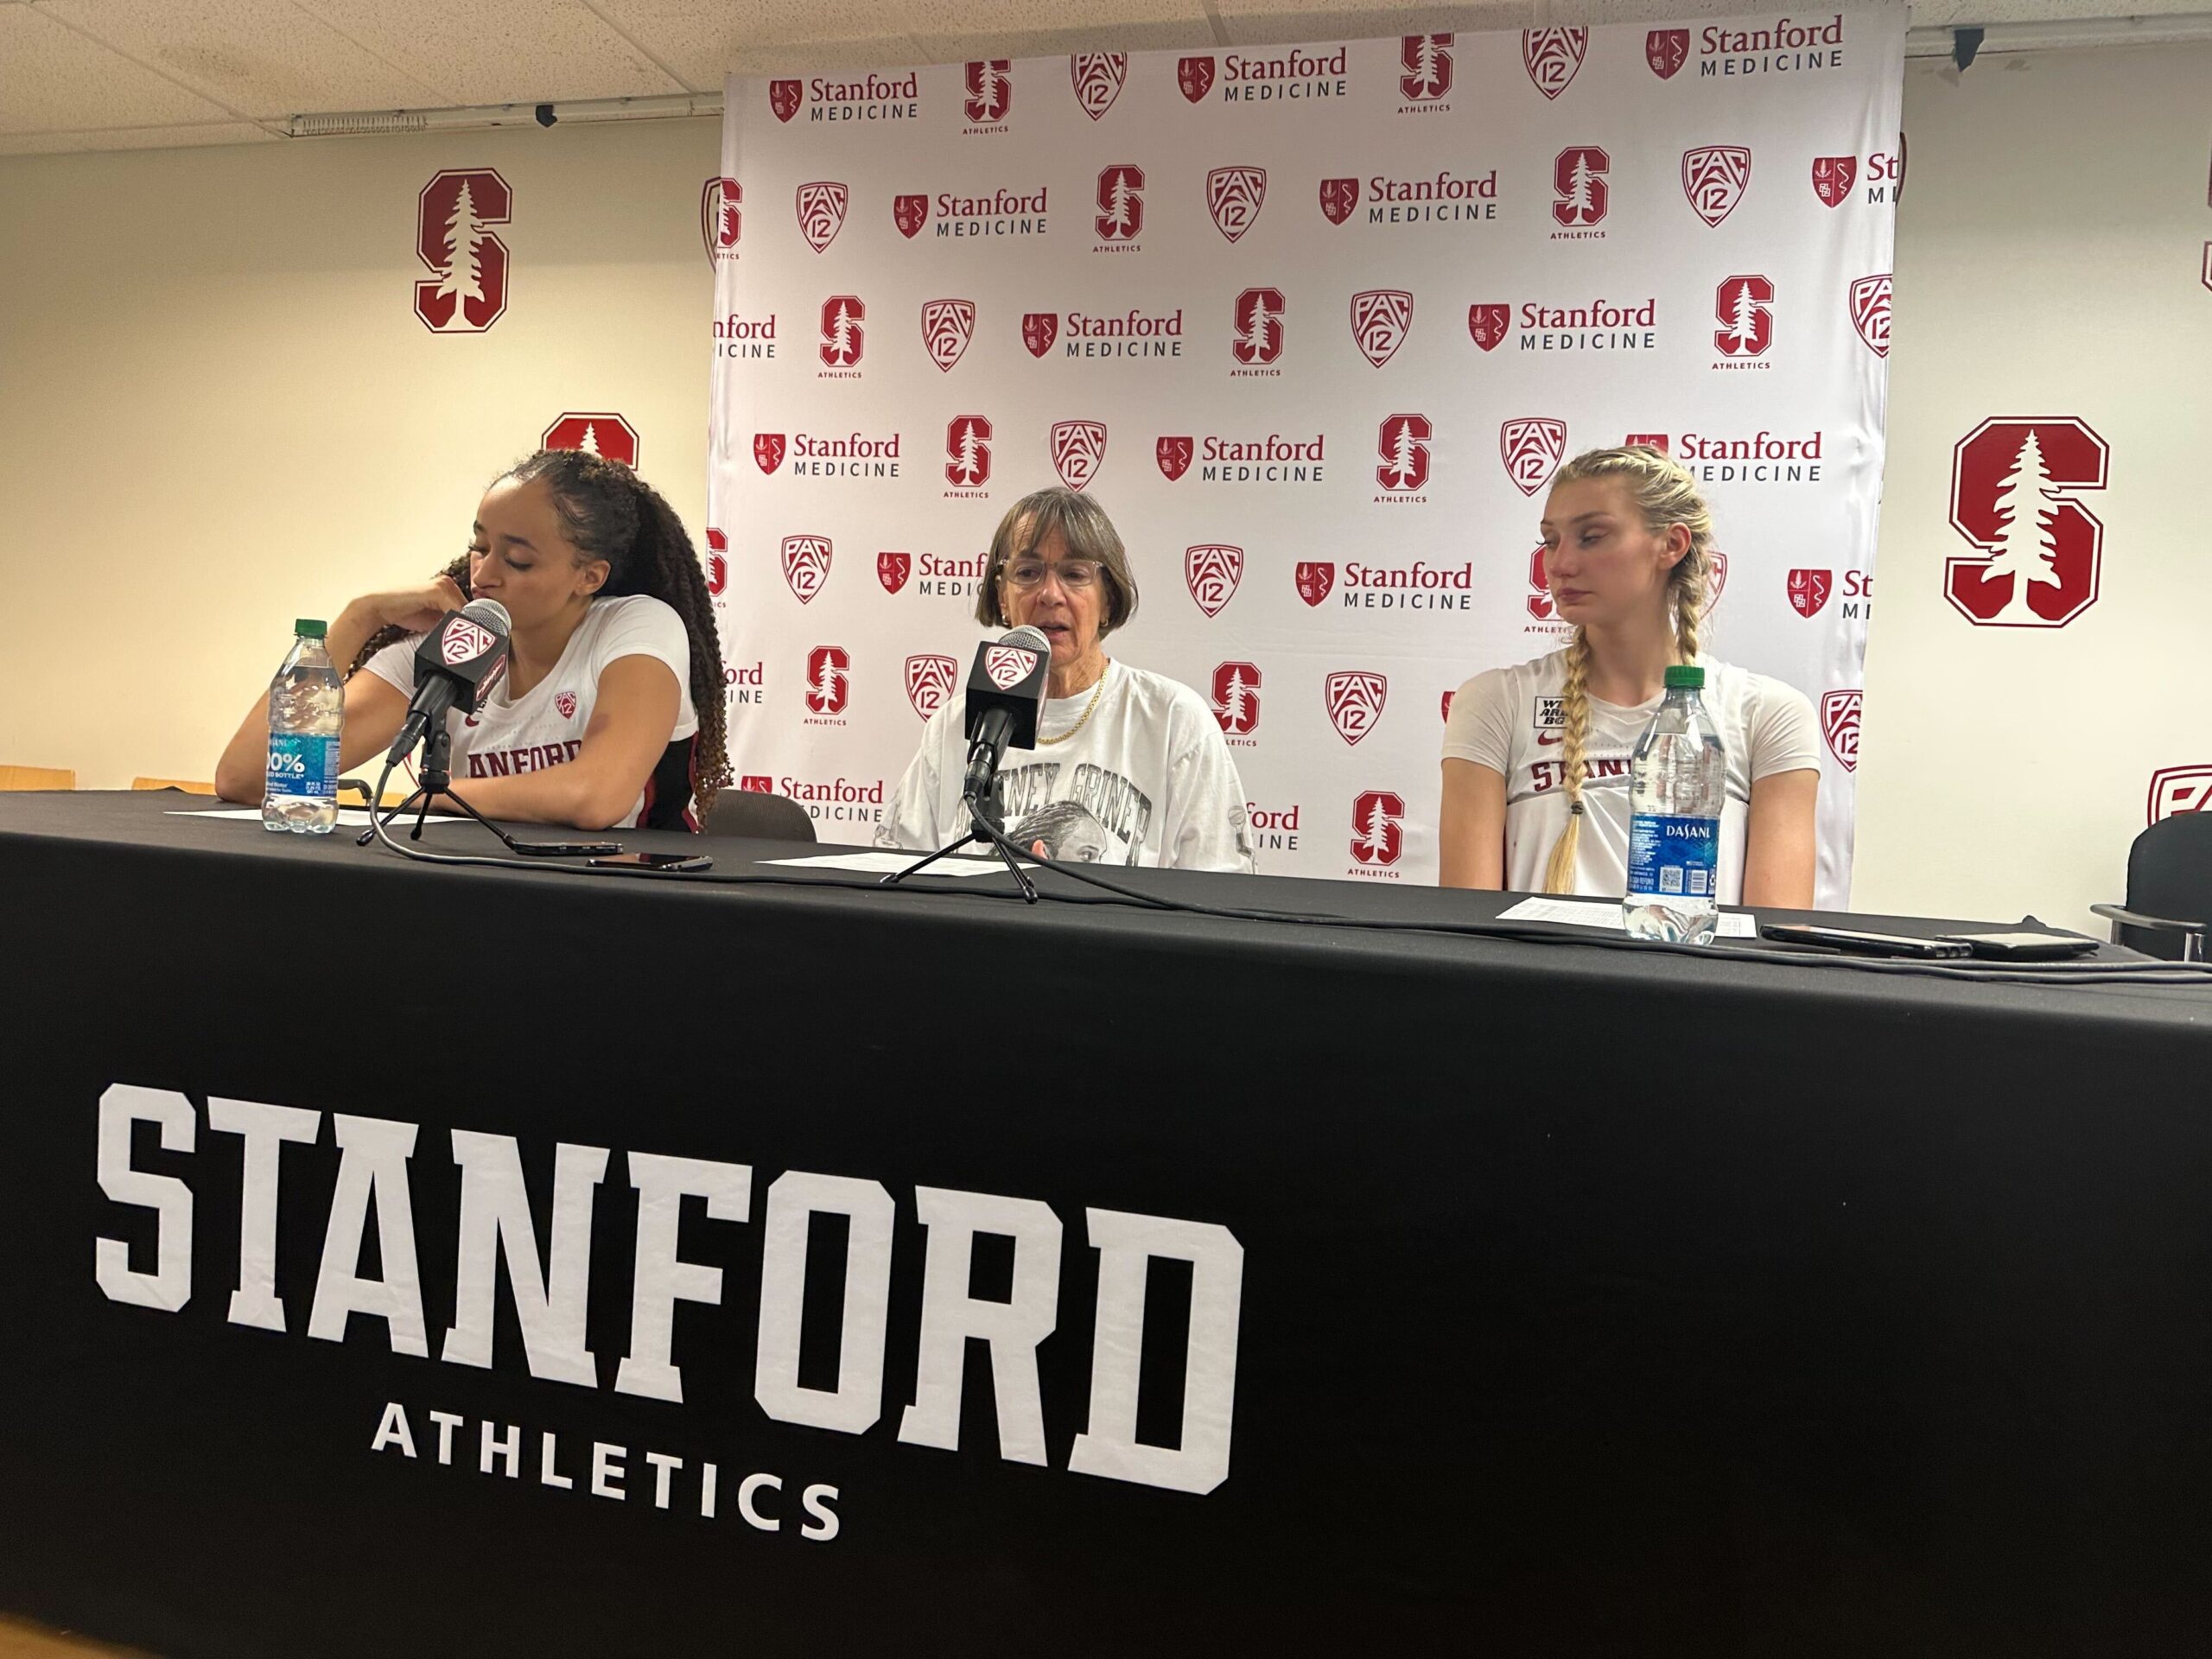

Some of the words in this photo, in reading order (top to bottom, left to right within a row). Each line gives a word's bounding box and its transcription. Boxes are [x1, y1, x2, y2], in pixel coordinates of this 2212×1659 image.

[1527, 26, 1585, 60] PAC
[1700, 16, 1842, 54] Stanford
[1074, 53, 1124, 87] PAC
[1225, 48, 1345, 81] Stanford
[1542, 60, 1567, 86] 12
[1700, 47, 1842, 77] MEDICINE
[810, 73, 918, 102] Stanford
[1085, 82, 1109, 106] 12
[1225, 80, 1346, 102] MEDICINE
[811, 104, 917, 121] MEDICINE
[1398, 104, 1450, 113] ATHLETICS
[963, 125, 1008, 135] ATHLETICS
[1687, 150, 1746, 188] PAC
[1211, 170, 1262, 207] PAC
[1369, 171, 1497, 202] Stanford
[1703, 188, 1728, 210] 12
[799, 187, 844, 219] PAC
[935, 187, 1047, 218] Stanford
[1370, 204, 1496, 223] MEDICINE
[938, 219, 1046, 237] MEDICINE
[1224, 206, 1246, 226] 12
[812, 220, 830, 238] 12
[715, 253, 739, 262] ETICS
[925, 303, 971, 338] PAC
[1068, 309, 1182, 337] Stanford
[1354, 295, 1410, 332] PAC
[1521, 299, 1655, 328] Stanford
[713, 314, 775, 339] nford
[720, 344, 774, 358] ICINE
[938, 337, 957, 356] 12
[1067, 341, 1181, 357] MEDICINE
[1369, 330, 1392, 351] 12
[1521, 333, 1654, 350] MEDICINE
[795, 433, 899, 458] Stanford
[1055, 425, 1103, 458] PAC
[1203, 434, 1324, 461] Stanford
[1505, 423, 1562, 460] PAC
[1681, 431, 1821, 460] Stanford
[795, 462, 899, 477] MEDICINE
[1068, 459, 1088, 478] 12
[1203, 467, 1323, 481] MEDICINE
[1520, 460, 1543, 479] 12
[785, 539, 829, 571] PAC
[919, 553, 988, 579] Stanf
[1189, 550, 1240, 584] PAC
[798, 571, 815, 589] 12
[1345, 563, 1471, 588] Stanford
[1203, 582, 1224, 601] 12
[1344, 593, 1471, 609] MEDICINE
[448, 643, 469, 658] 12
[988, 648, 1035, 673] PAC
[909, 659, 954, 692] PAC
[997, 669, 1018, 682] 12
[921, 691, 939, 709] 12
[1329, 675, 1383, 710] PAC
[1344, 710, 1365, 729] 12
[781, 777, 883, 804] Stanford
[809, 806, 882, 824] DICINE
[1666, 824, 1710, 840] DASANI
[1348, 869, 1399, 878] ATHLETICS
[96, 1084, 1243, 1498] STANFORD
[372, 1400, 842, 1541] ATHLETICS
